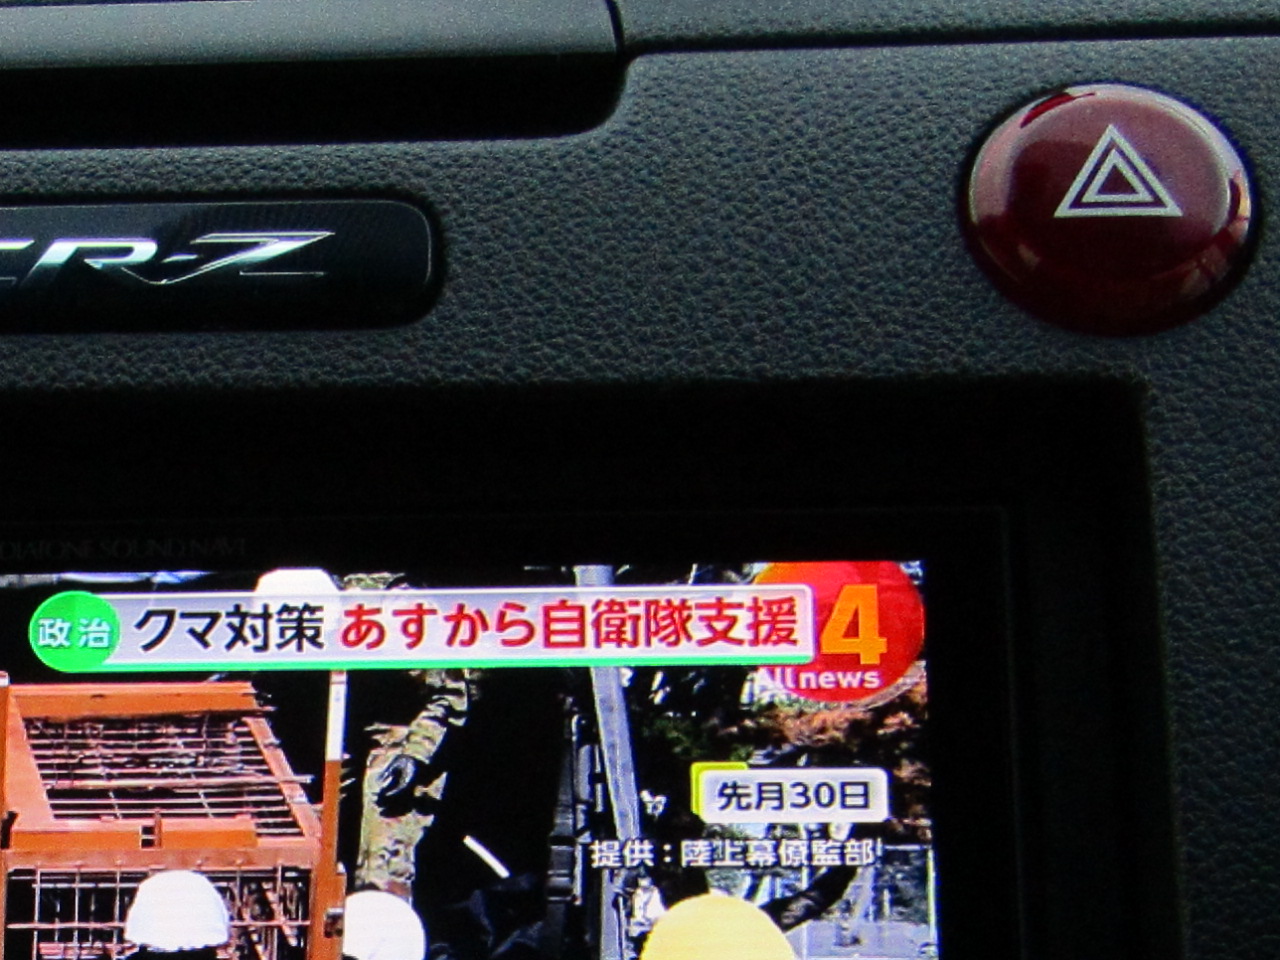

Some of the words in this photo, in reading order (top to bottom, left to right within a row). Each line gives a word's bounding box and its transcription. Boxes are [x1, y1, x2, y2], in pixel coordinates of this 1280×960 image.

[37, 618, 113, 651] 政治
[133, 602, 325, 655] クマ対策
[340, 595, 799, 650] あすから自衛隊支援
[820, 583, 888, 665] 4
[798, 668, 883, 690] news
[716, 780, 871, 812] 先月30日
